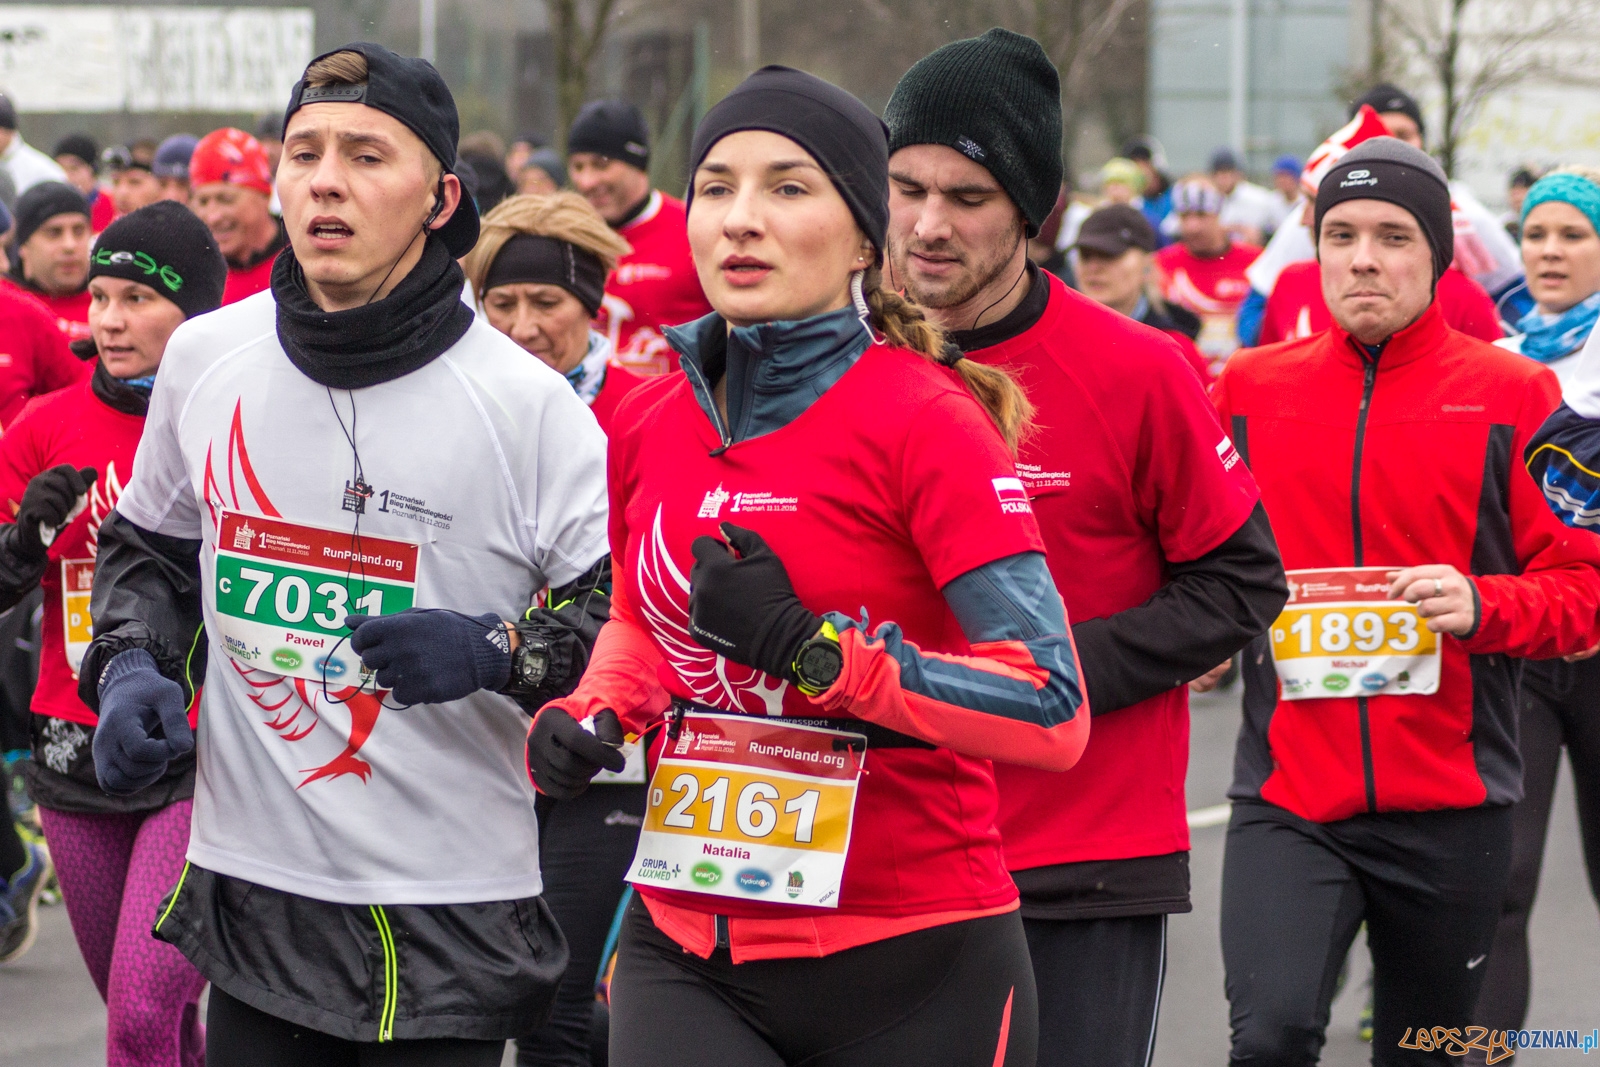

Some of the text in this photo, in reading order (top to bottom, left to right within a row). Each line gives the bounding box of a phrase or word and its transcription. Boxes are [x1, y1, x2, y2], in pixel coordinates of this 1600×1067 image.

[1036, 479, 1070, 487] 11.11.2016
[379, 490, 425, 513] 1 Poznański
[730, 492, 742, 512] 1
[389, 499, 453, 521] Bieg Niepodległości
[419, 515, 450, 530] 11.11.2016
[259, 532, 266, 548] 1
[323, 547, 403, 571] RunPoland.org
[219, 577, 232, 594] C
[240, 567, 384, 630] 7031
[71, 613, 81, 627] D
[1274, 629, 1285, 642] D
[1291, 611, 1420, 653] 1893
[286, 633, 324, 648] Paweł
[694, 732, 702, 750] 1
[750, 742, 845, 769] RunPoland.org
[651, 788, 664, 807] D
[663, 773, 820, 843] 2161
[703, 844, 750, 860] Natalia
[642, 859, 667, 870] GRUPA
[638, 868, 671, 881] LUXMED
[695, 871, 719, 882] energy
[819, 890, 836, 903] ROGAL
